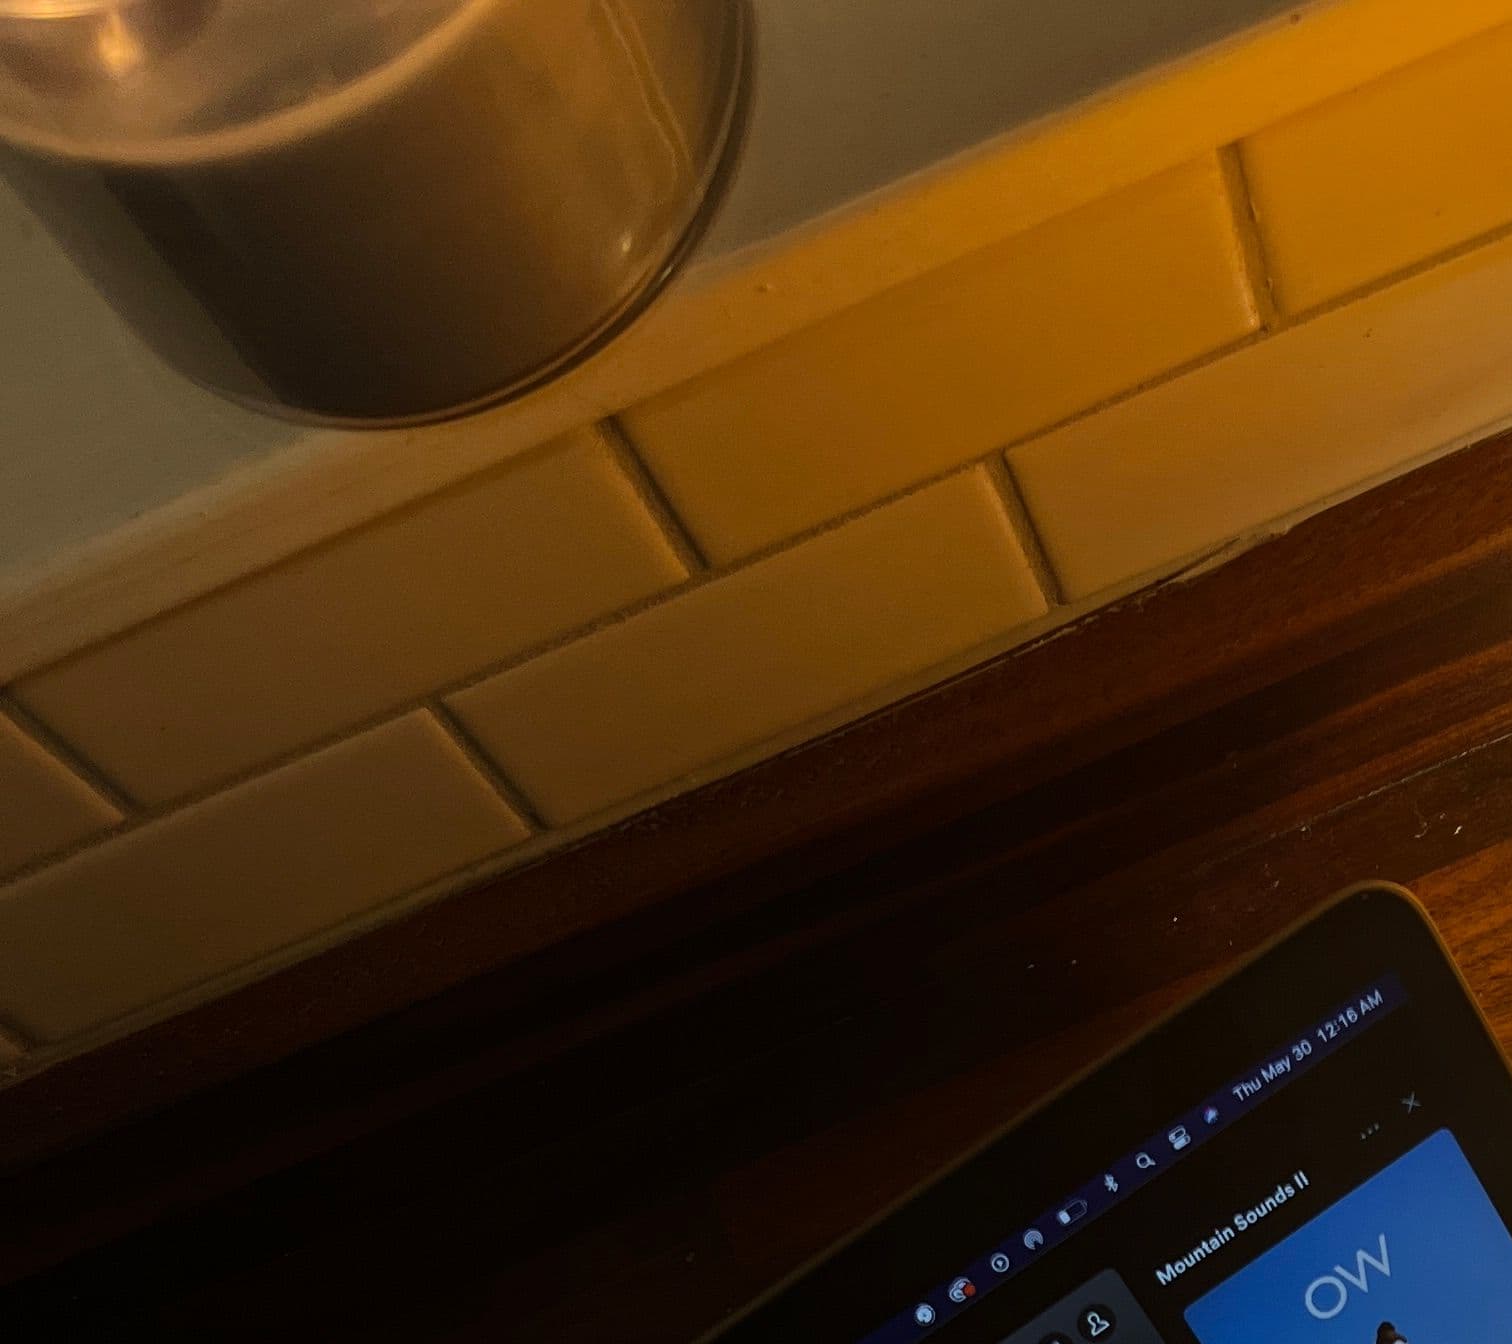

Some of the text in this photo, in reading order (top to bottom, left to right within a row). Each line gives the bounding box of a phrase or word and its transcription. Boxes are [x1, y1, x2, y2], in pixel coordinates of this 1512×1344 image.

[1231, 988, 1383, 1101] Thu May 30 12:16 AM
[1155, 1169, 1309, 1286] Mountain Sounds II
[1304, 1232, 1391, 1319] OW
